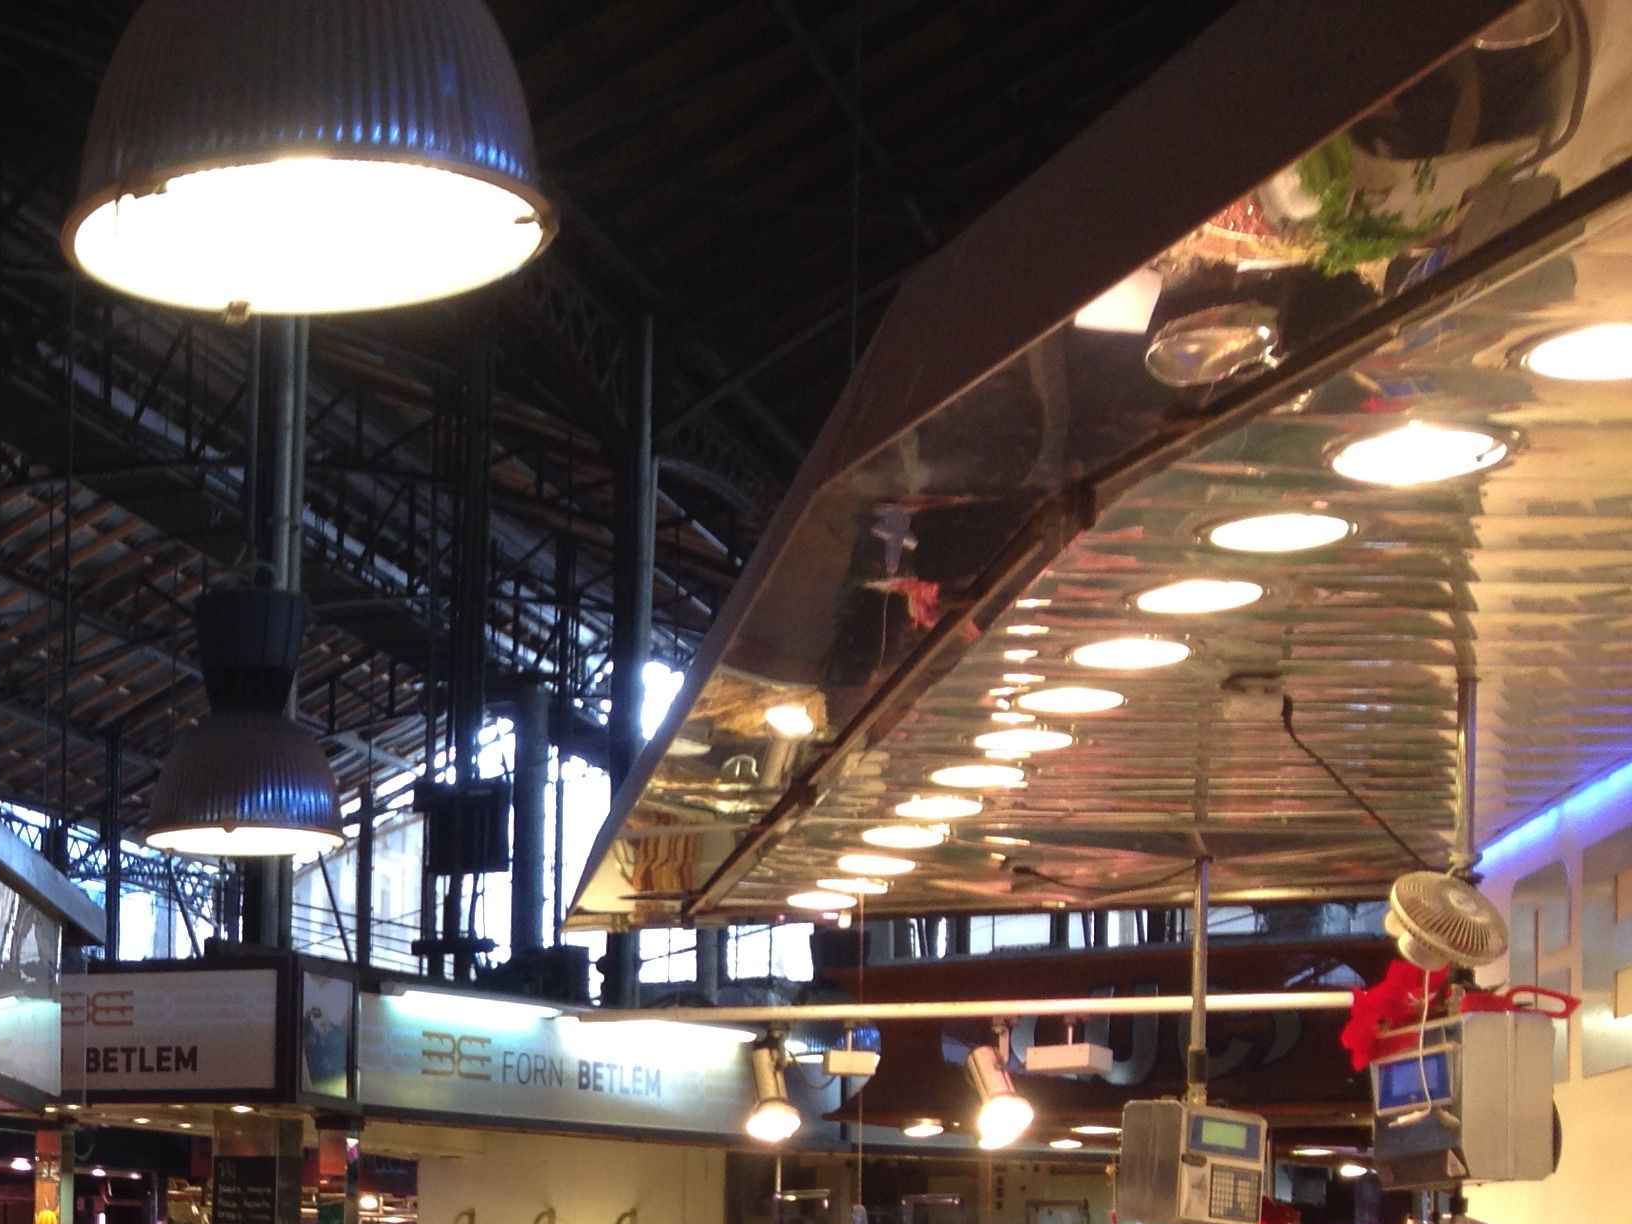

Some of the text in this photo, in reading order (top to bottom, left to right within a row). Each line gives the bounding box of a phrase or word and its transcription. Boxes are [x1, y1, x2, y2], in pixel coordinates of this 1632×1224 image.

[86, 1046, 197, 1073] BETLEM
[502, 1051, 661, 1097] FORN BETLEM
